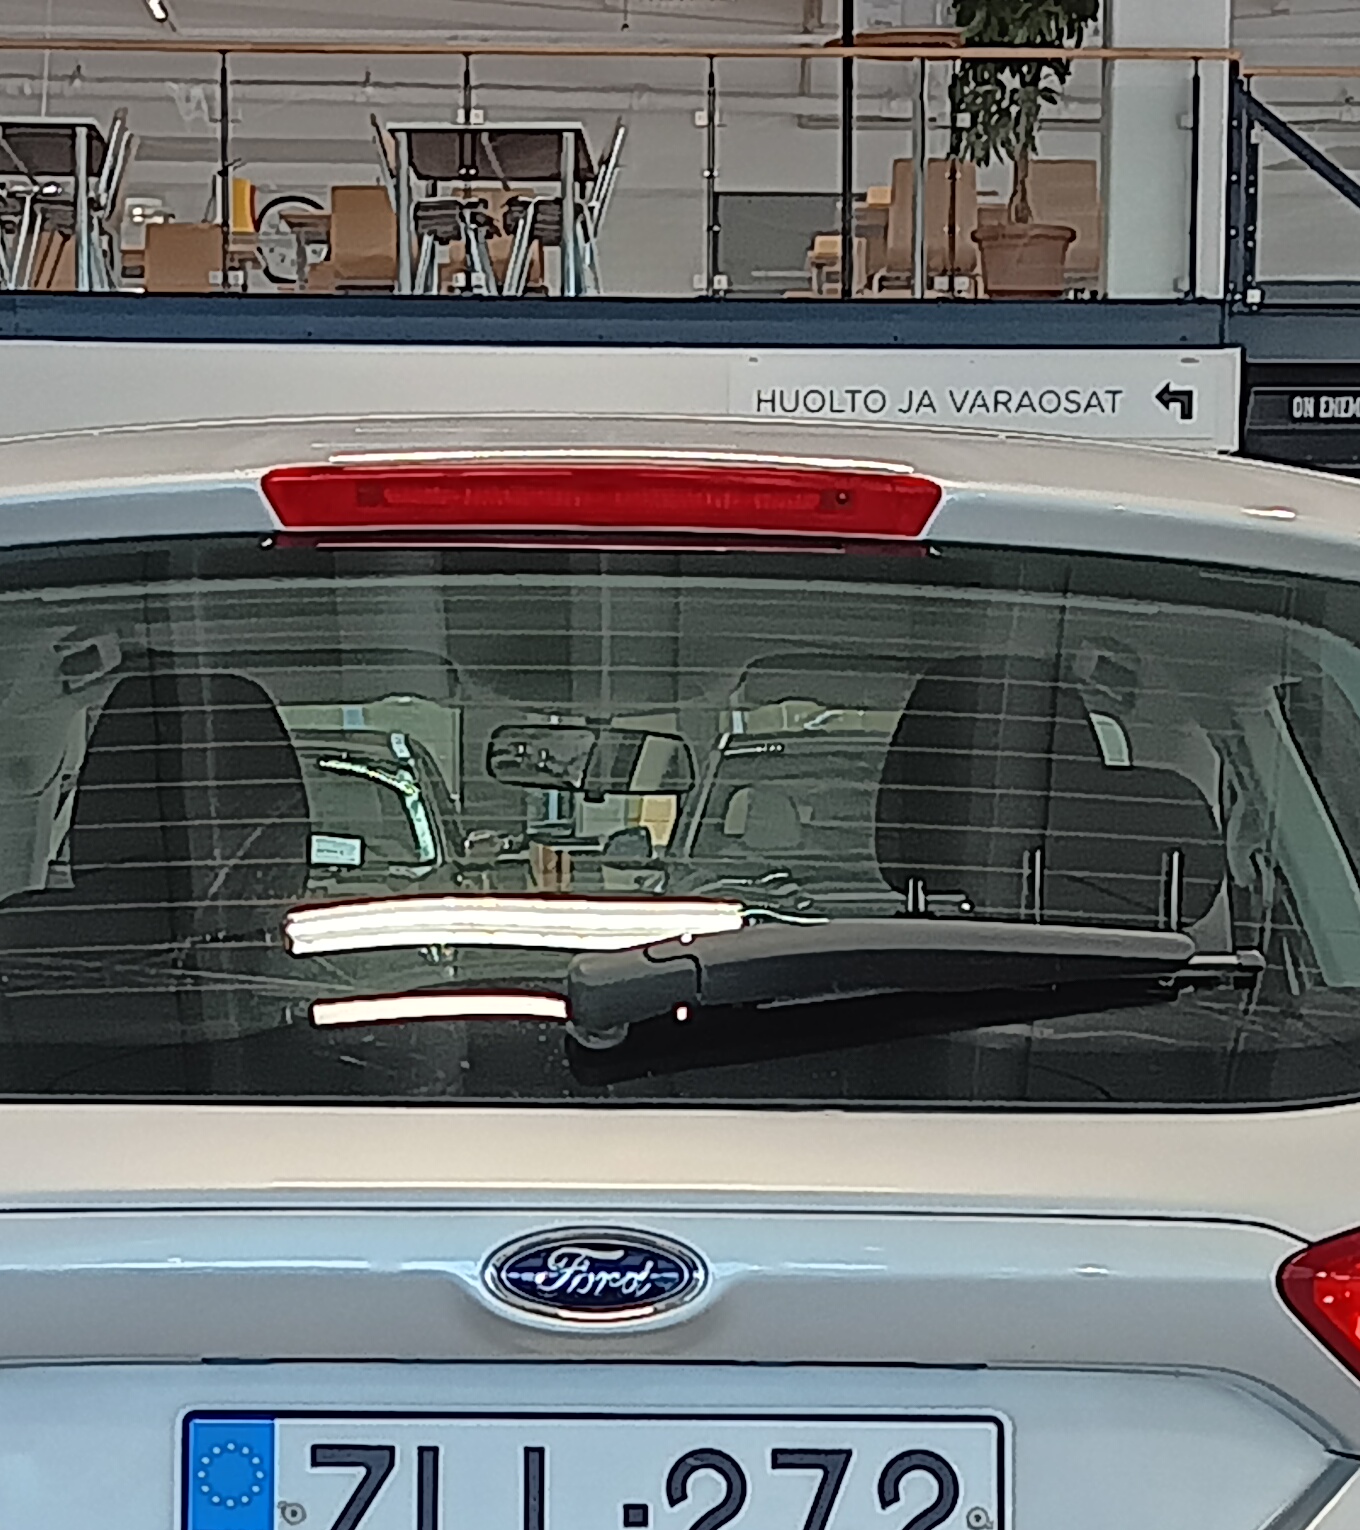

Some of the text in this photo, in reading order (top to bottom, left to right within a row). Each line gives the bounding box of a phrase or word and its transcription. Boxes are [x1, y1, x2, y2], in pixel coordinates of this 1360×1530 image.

[756, 389, 1123, 414] HUOLTO JA VARAOSAT
[536, 1247, 654, 1297] Ford
